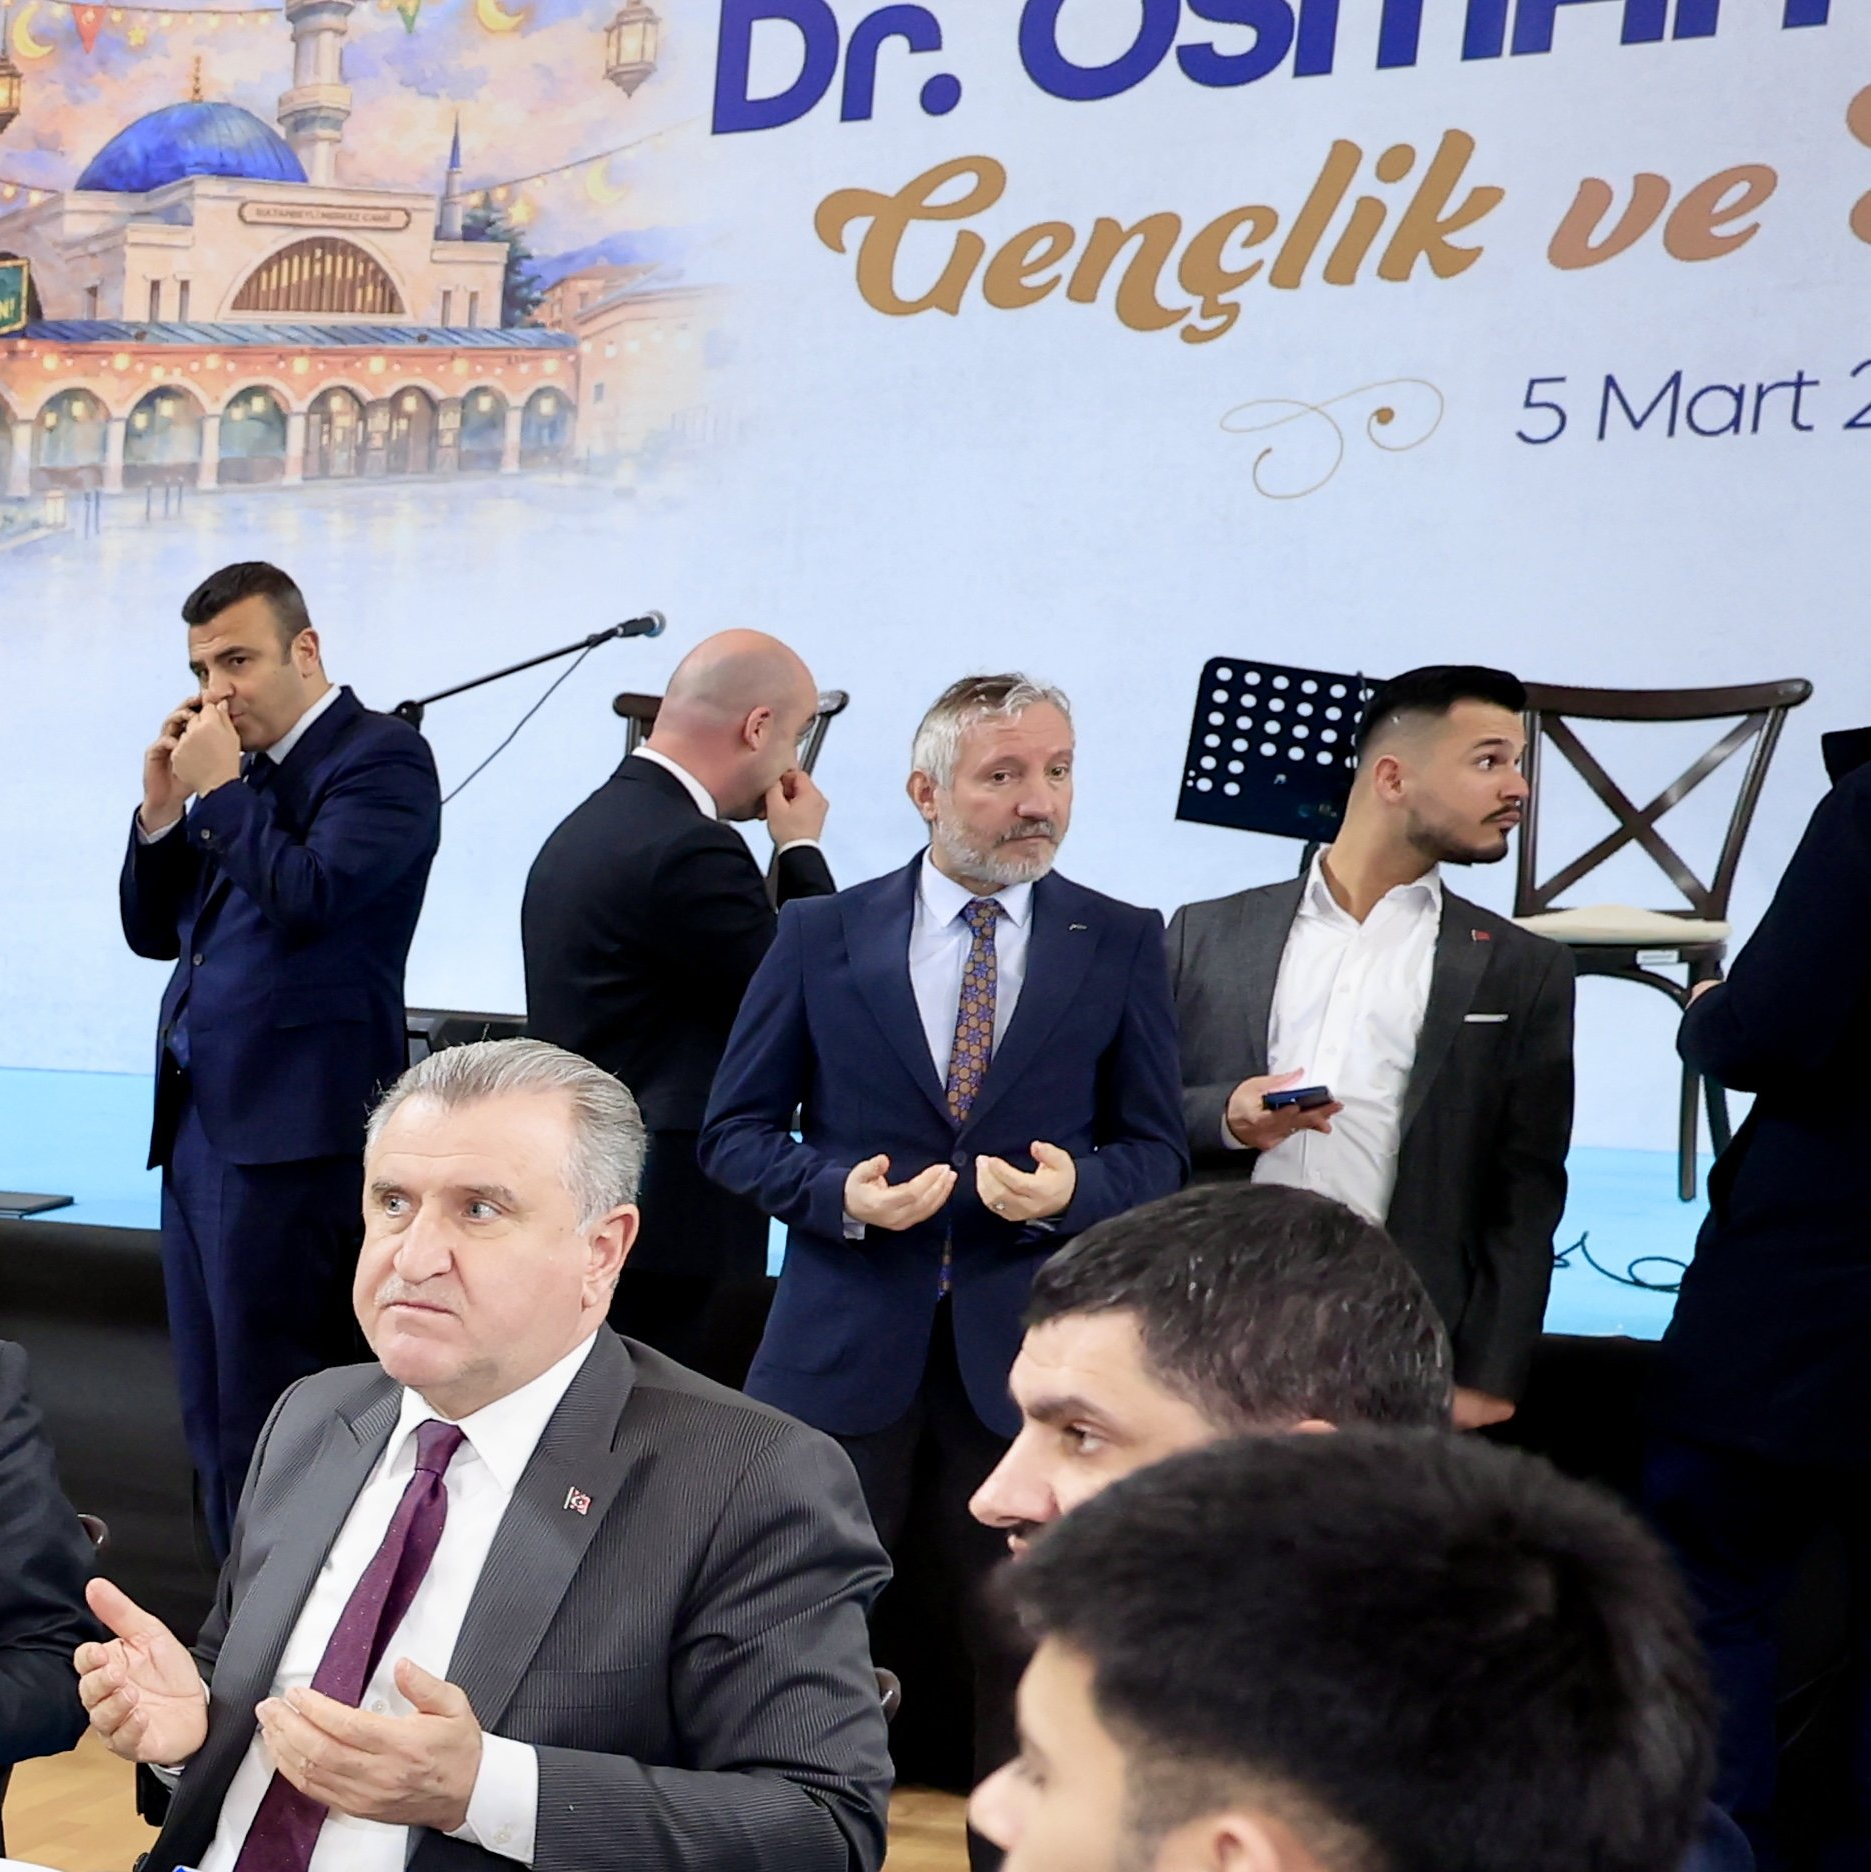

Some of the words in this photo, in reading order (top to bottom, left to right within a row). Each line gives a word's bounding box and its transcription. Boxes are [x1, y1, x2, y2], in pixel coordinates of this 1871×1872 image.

[712, 0, 962, 135] Dr.
[1019, 0, 1830, 101] OSM
[812, 128, 1505, 345] Gençlik
[1546, 163, 1779, 270] ve
[1515, 375, 1567, 445] 5
[1597, 369, 1820, 441] Mart
